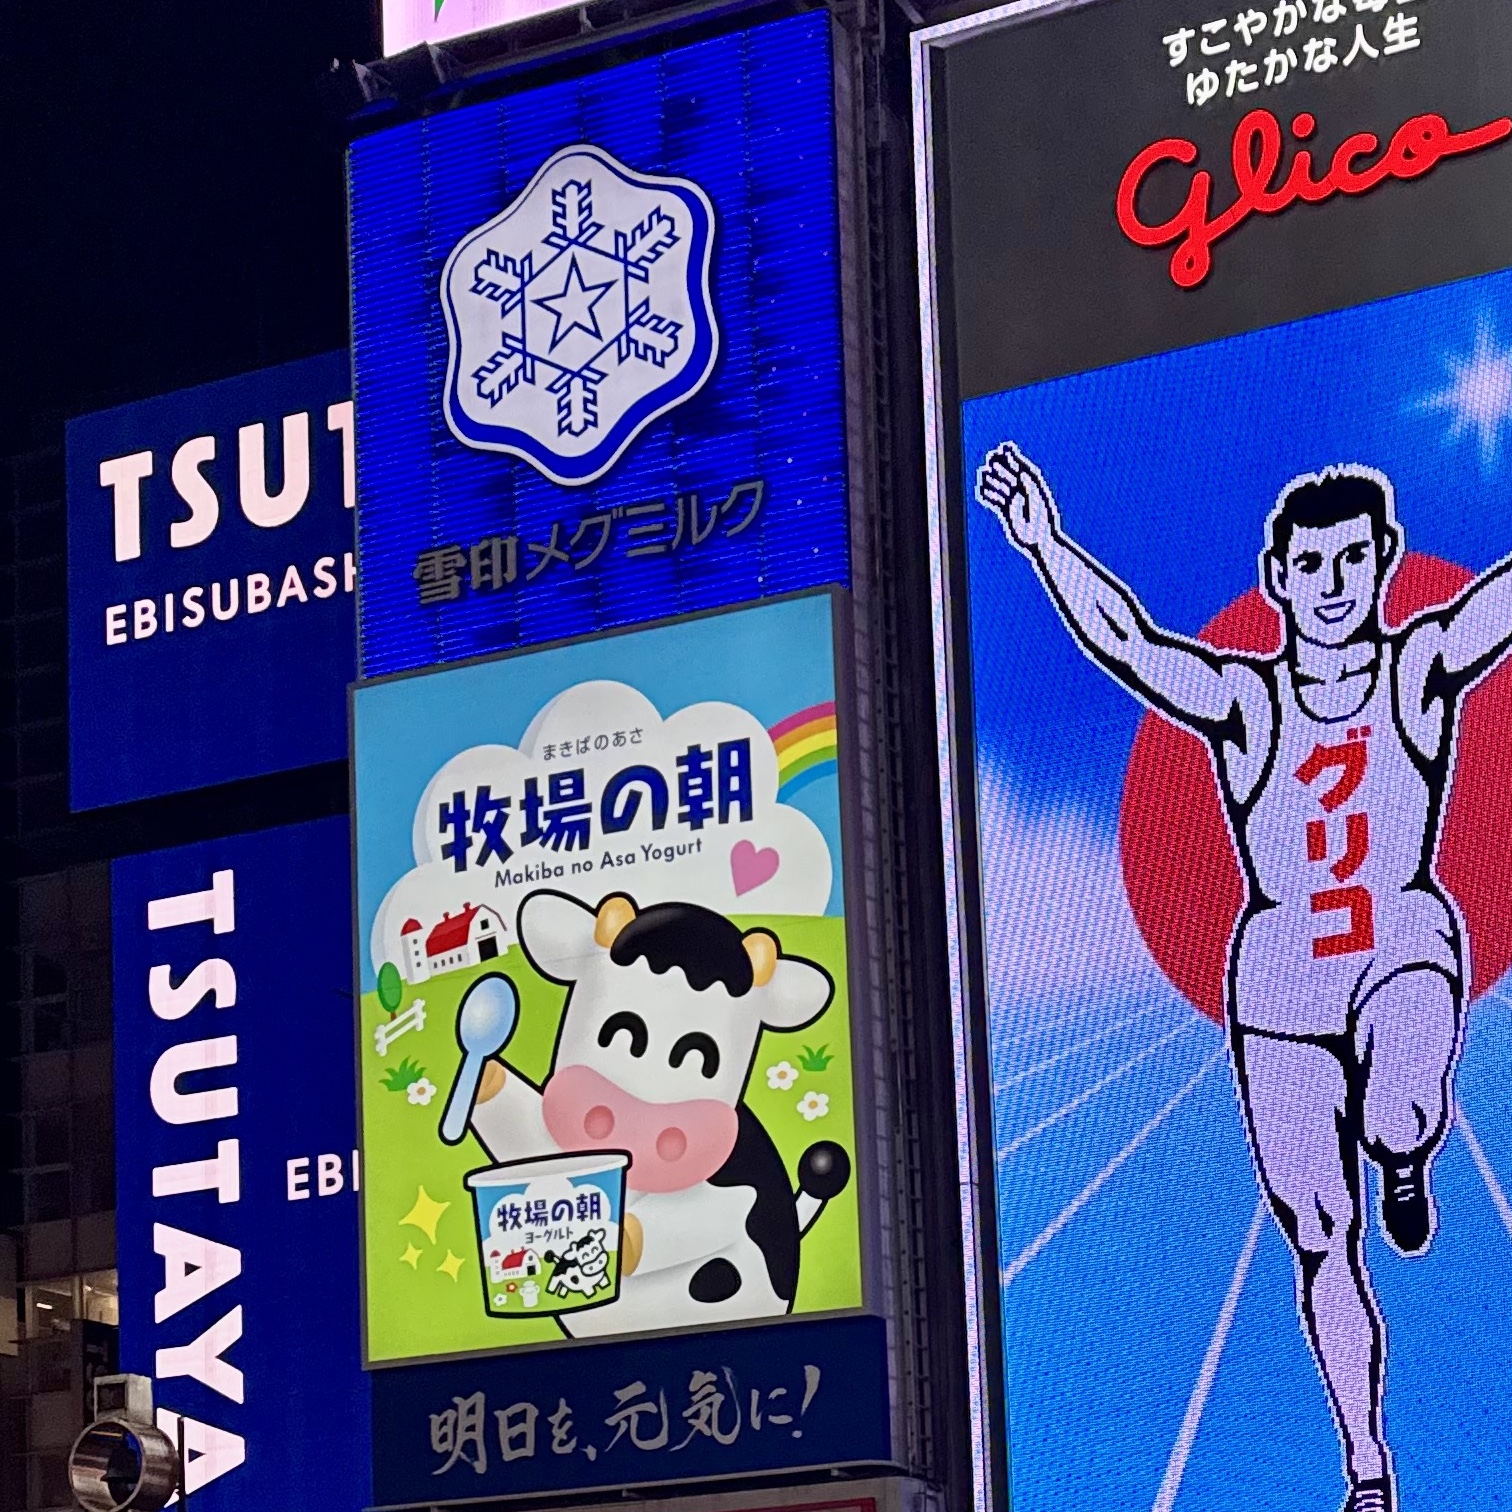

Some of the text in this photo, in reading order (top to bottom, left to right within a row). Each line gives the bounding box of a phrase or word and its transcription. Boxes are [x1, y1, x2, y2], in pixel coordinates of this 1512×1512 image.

[1162, 0, 1414, 67] すこやかな
[1186, 13, 1421, 106] ゆたかな人生
[1116, 109, 1512, 287] Glico
[413, 480, 764, 605] 雪印メグミルク
[542, 727, 644, 761] まきばのあさ
[439, 737, 753, 873] 牧場の朝
[1294, 725, 1375, 960] グリコ
[494, 838, 702, 888] Makiba no Asa Yogurt
[148, 869, 245, 1507] TSUTAYA
[497, 1192, 601, 1232] 牧場の朝
[525, 1226, 573, 1244] ヨーグルト
